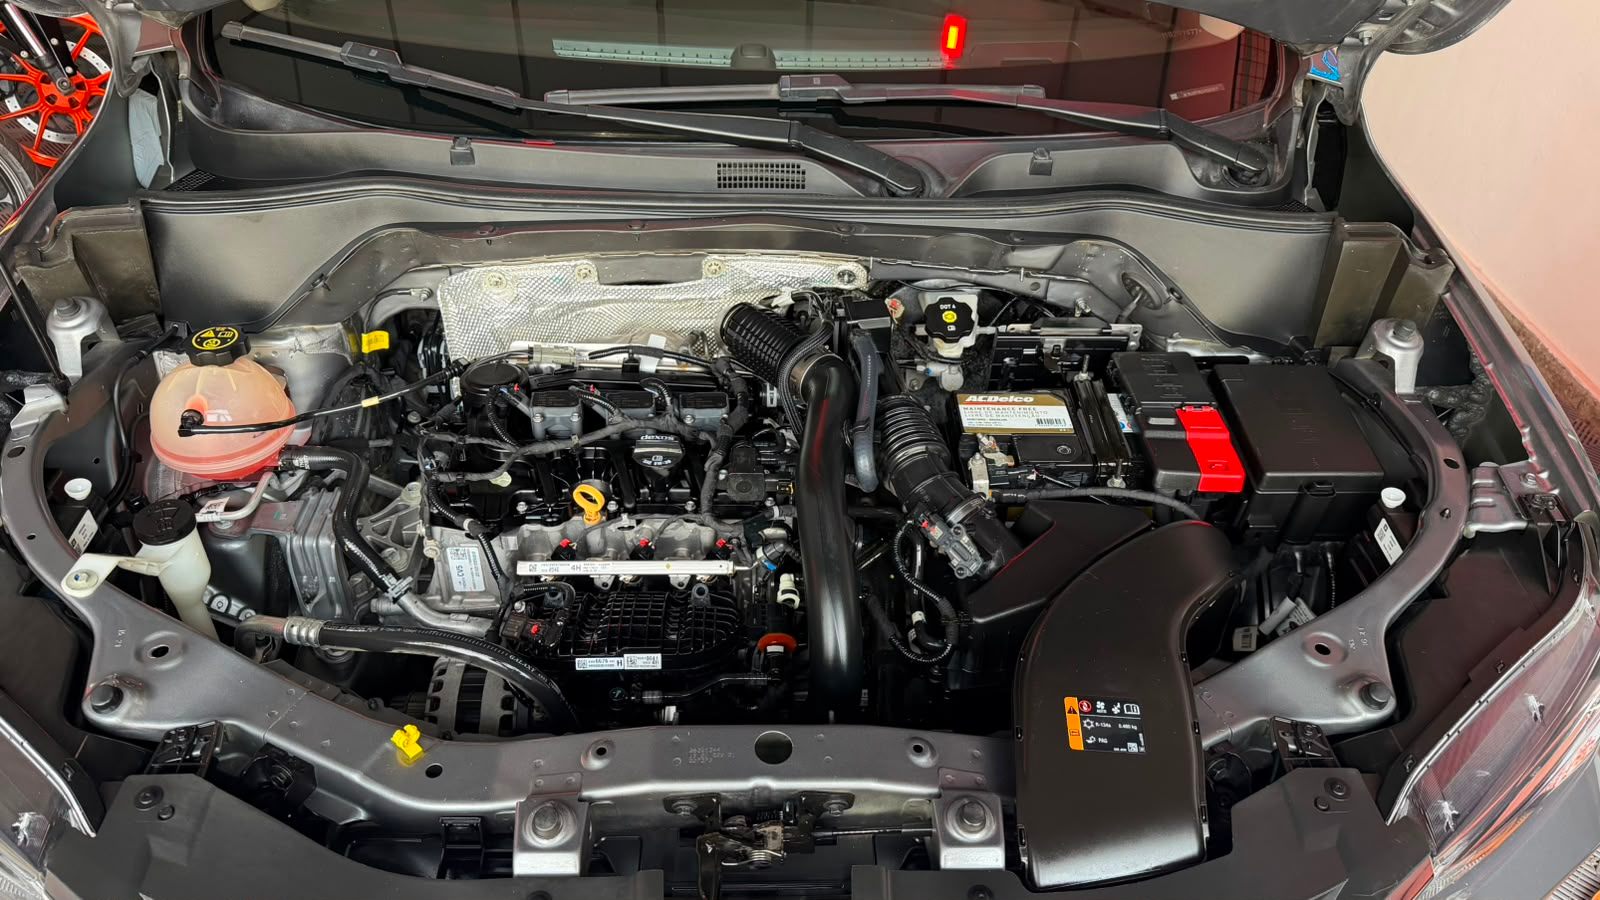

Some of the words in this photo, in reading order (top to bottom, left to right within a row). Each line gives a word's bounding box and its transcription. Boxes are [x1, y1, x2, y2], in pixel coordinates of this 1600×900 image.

[570, 563, 582, 572] 4H
[509, 654, 536, 673] GALAXY
[616, 659, 623, 667] H
